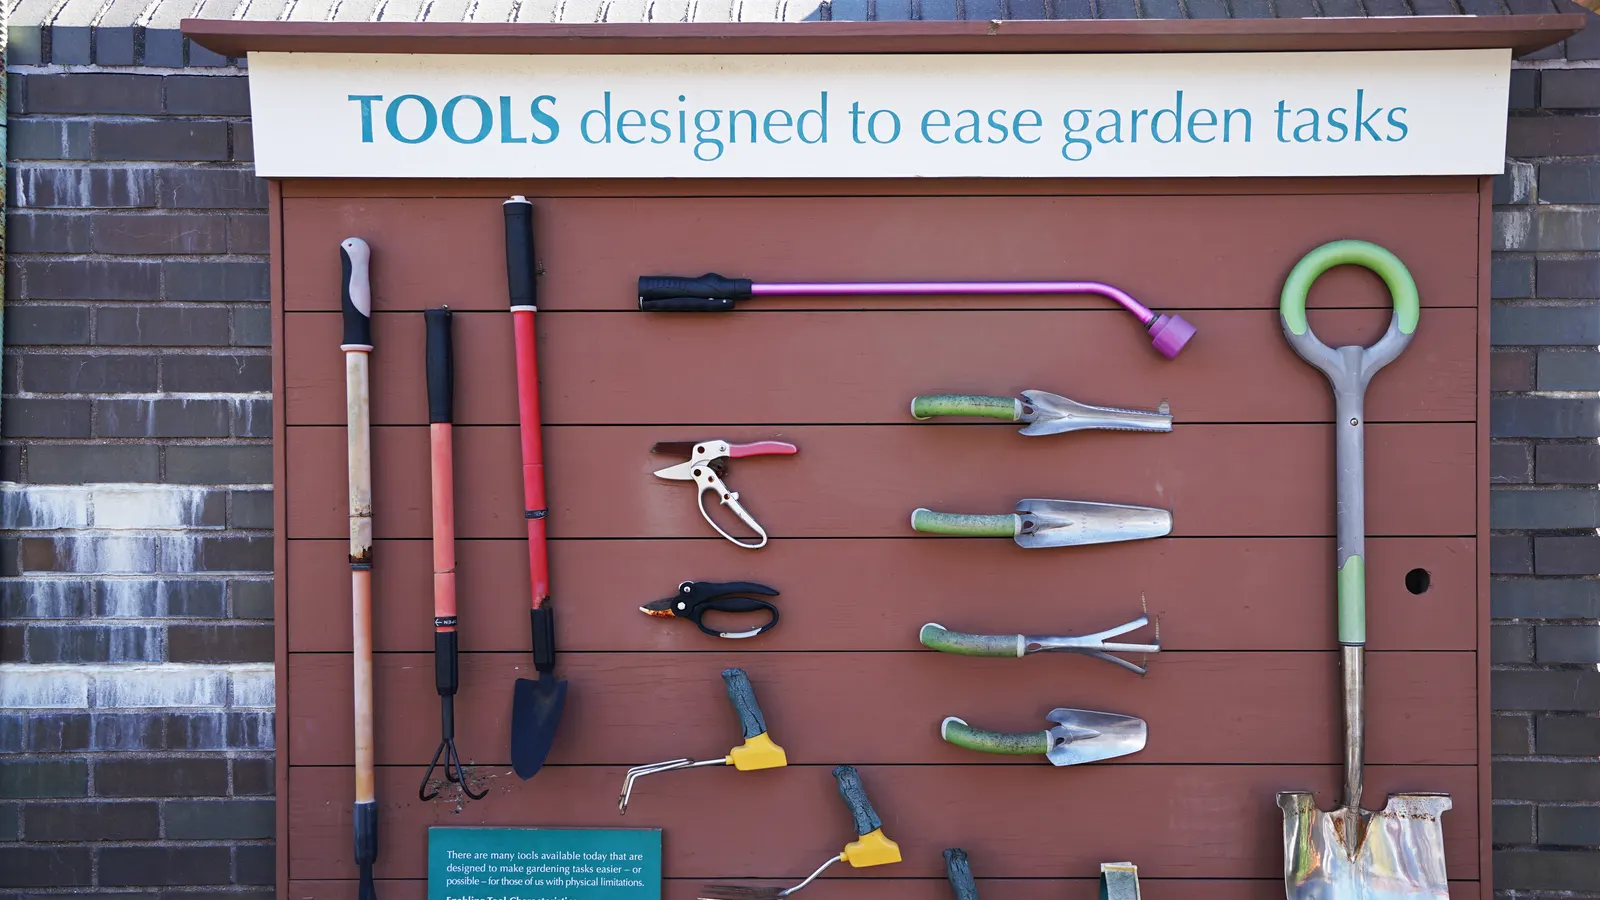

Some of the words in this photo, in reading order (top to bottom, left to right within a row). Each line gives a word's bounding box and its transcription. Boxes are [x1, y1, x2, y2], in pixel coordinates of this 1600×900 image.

[347, 93, 561, 145] TOOLS
[580, 90, 828, 161] designed
[848, 101, 901, 145] to
[920, 109, 1043, 145] ease
[1061, 89, 1253, 161] garden
[1273, 88, 1409, 144] tasks
[446, 850, 471, 860] There
[474, 852, 488, 860] are
[490, 852, 515, 862] many
[517, 850, 539, 860] tools
[540, 850, 581, 860] available
[583, 851, 607, 862] today
[609, 851, 627, 861] that
[628, 853, 643, 861] are
[446, 863, 486, 875] designed
[488, 864, 498, 873] to
[499, 863, 524, 873] make
[526, 863, 571, 875] gardening
[572, 864, 594, 873] tasks
[596, 864, 622, 874] easier
[446, 876, 480, 887] possible
[488, 876, 500, 886] for
[501, 876, 523, 886] those
[524, 876, 534, 886] of
[545, 877, 564, 886] with
[565, 877, 599, 888] physical
[600, 877, 645, 887] limitations.
